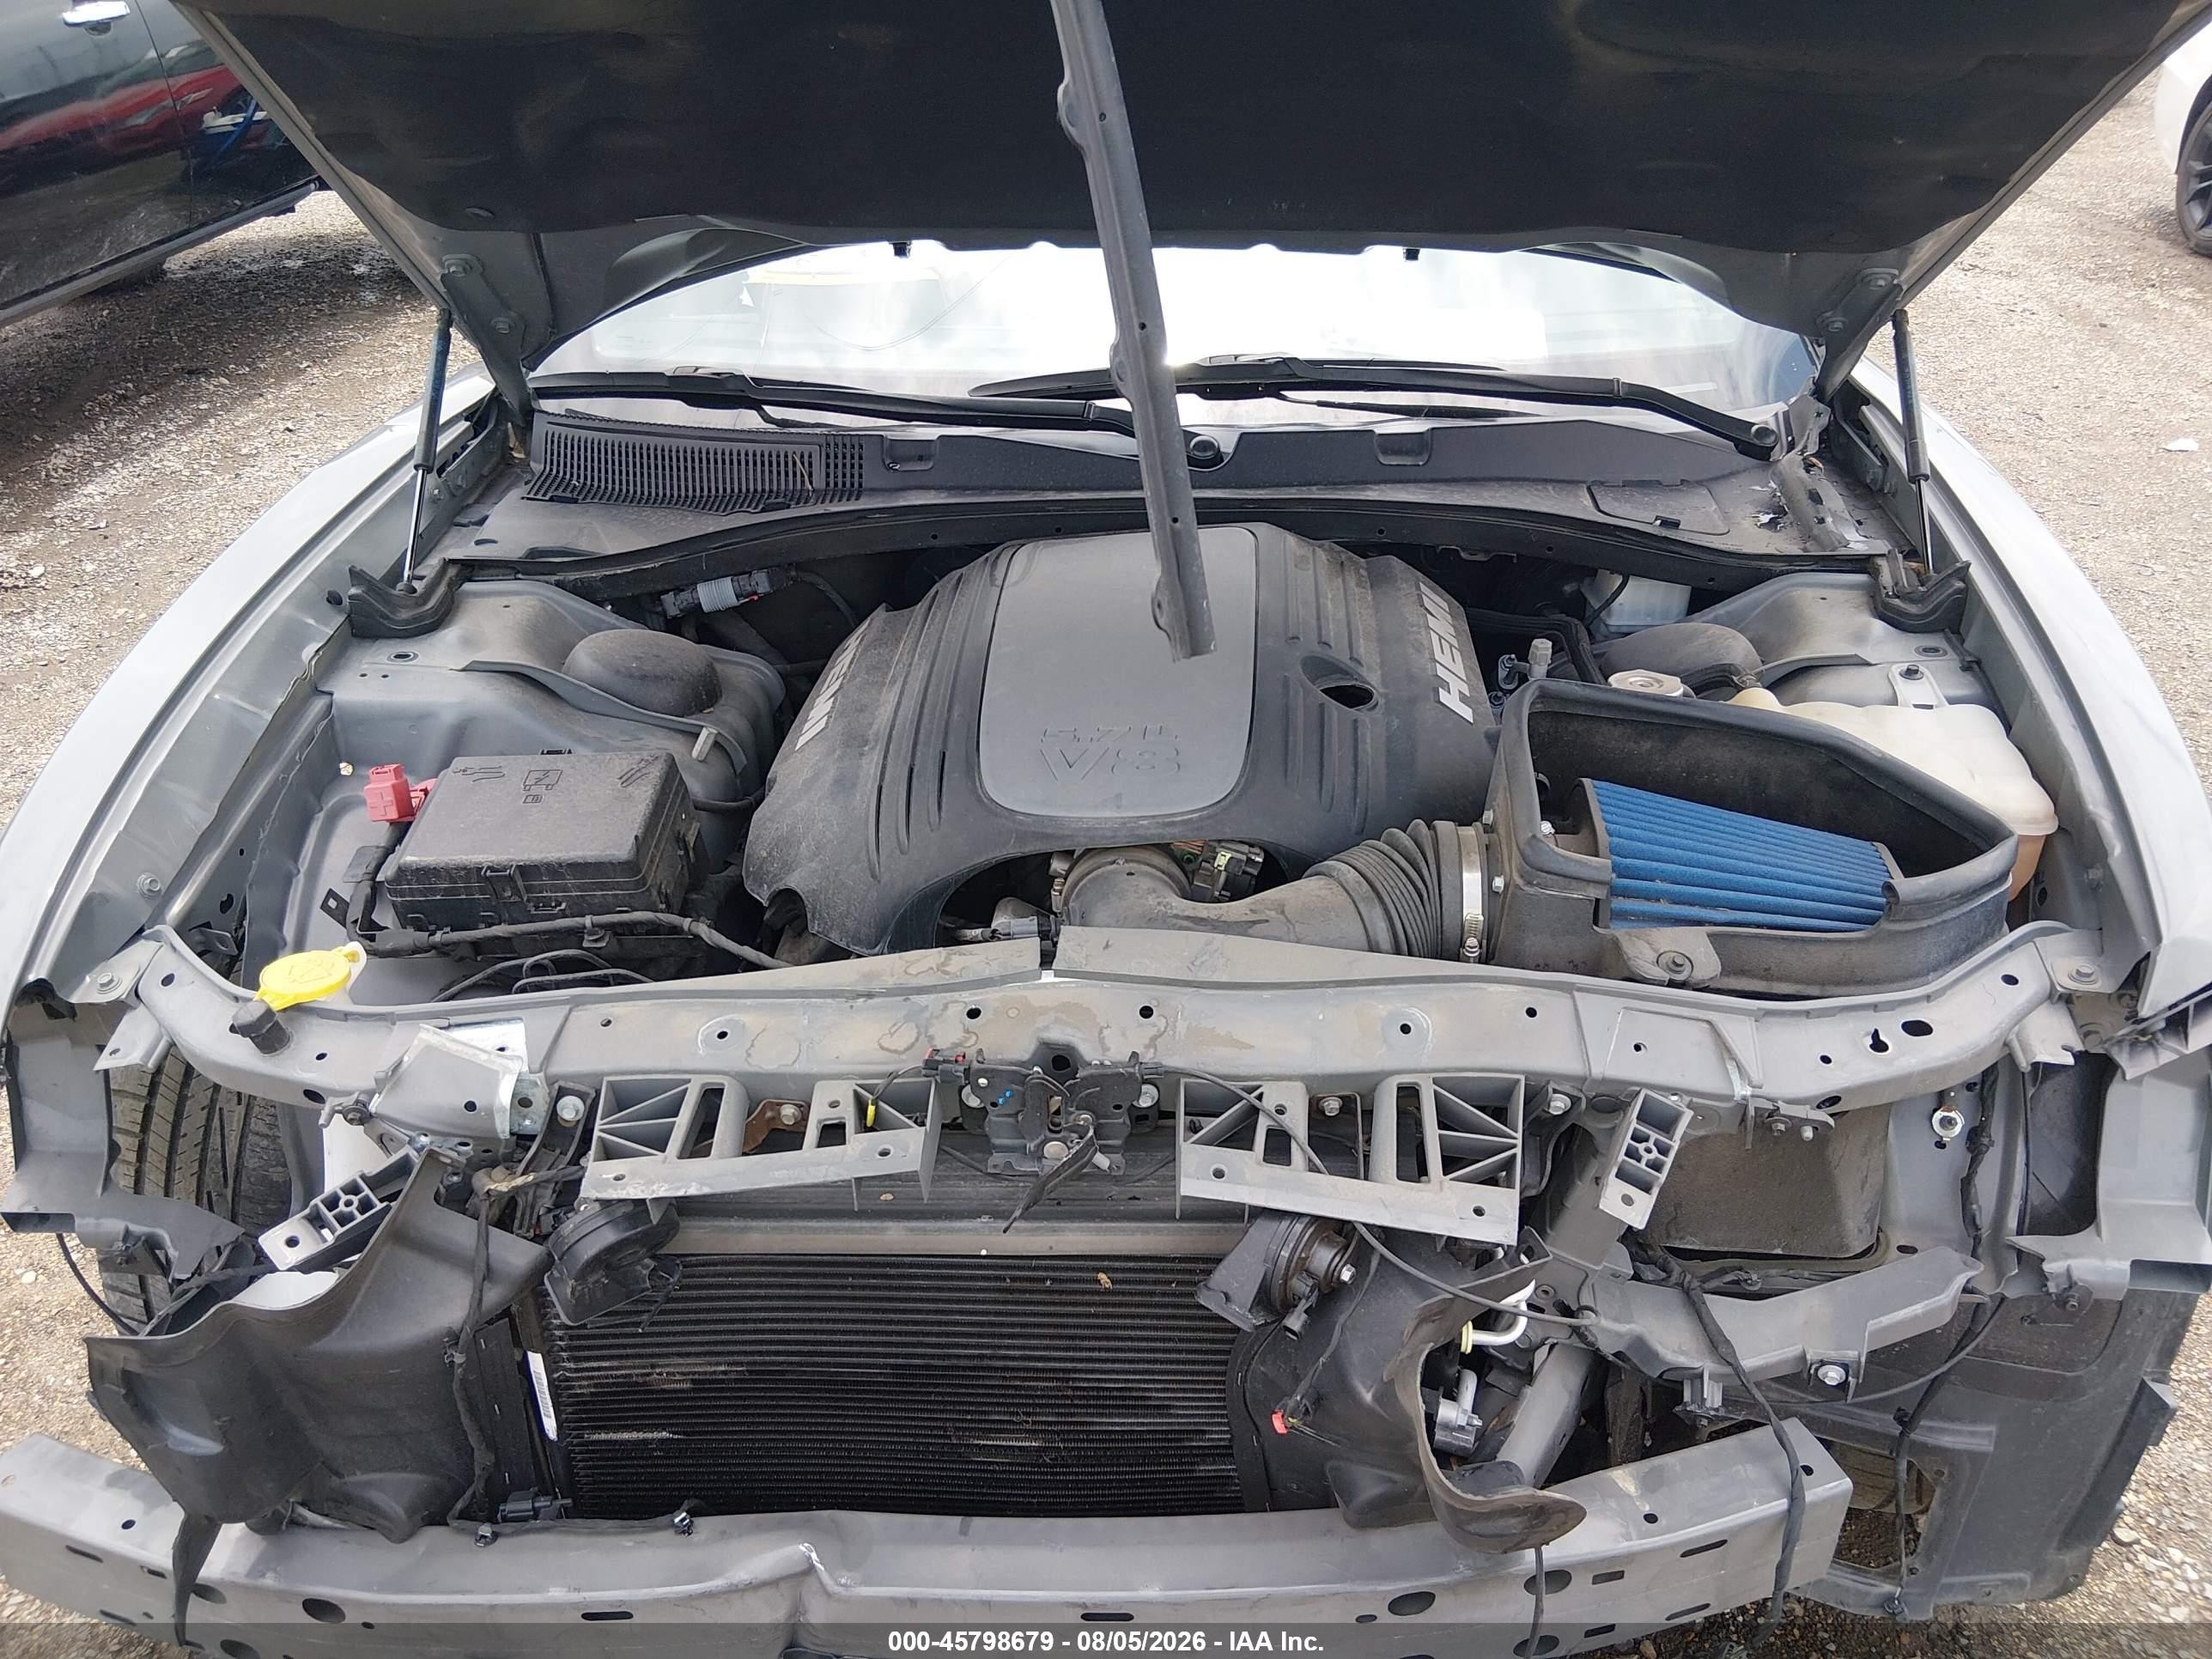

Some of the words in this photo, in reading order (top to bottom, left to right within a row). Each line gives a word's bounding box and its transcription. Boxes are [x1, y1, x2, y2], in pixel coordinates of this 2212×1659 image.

[795, 617, 871, 751] HEMI
[1419, 582, 1474, 724] HEMI
[1038, 744, 1181, 783] V8
